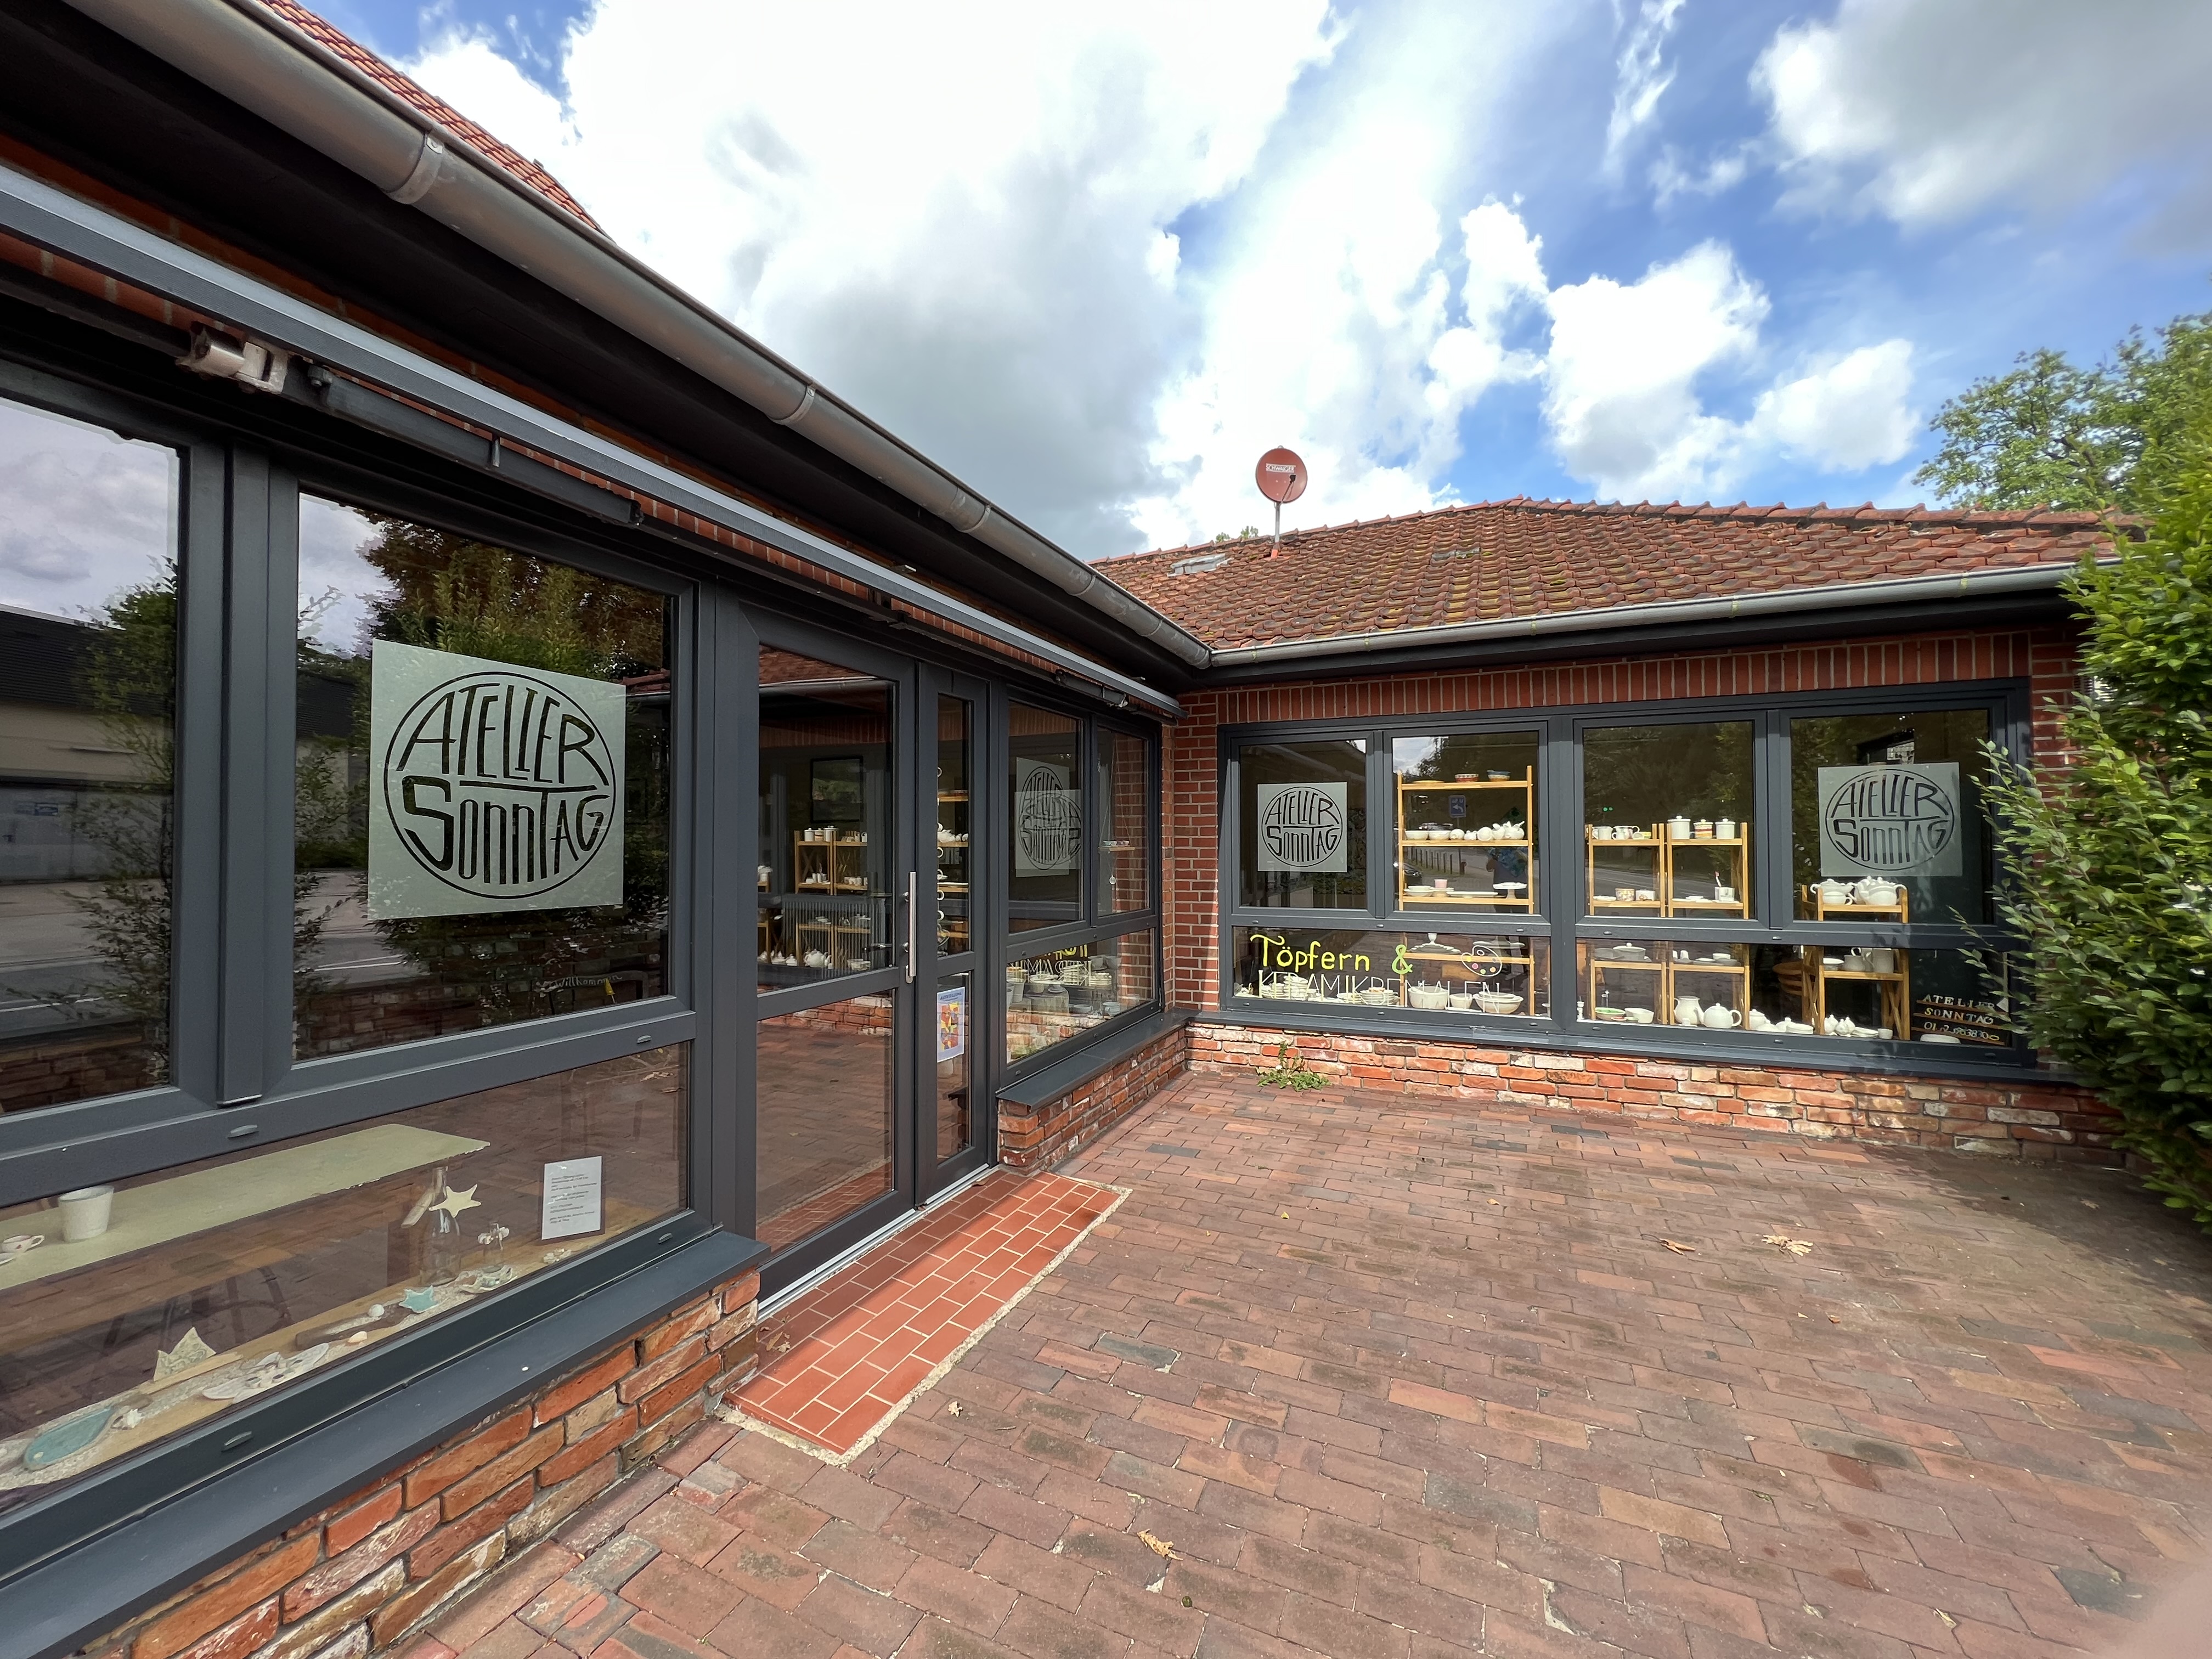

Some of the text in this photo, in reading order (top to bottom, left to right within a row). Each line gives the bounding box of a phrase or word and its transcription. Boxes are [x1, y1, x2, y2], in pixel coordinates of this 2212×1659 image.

[395, 682, 610, 786] ATELIER
[1265, 790, 1340, 825] ATELIER
[1830, 774, 1949, 818] ATELIER
[1250, 934, 1414, 974] Töpfern &
